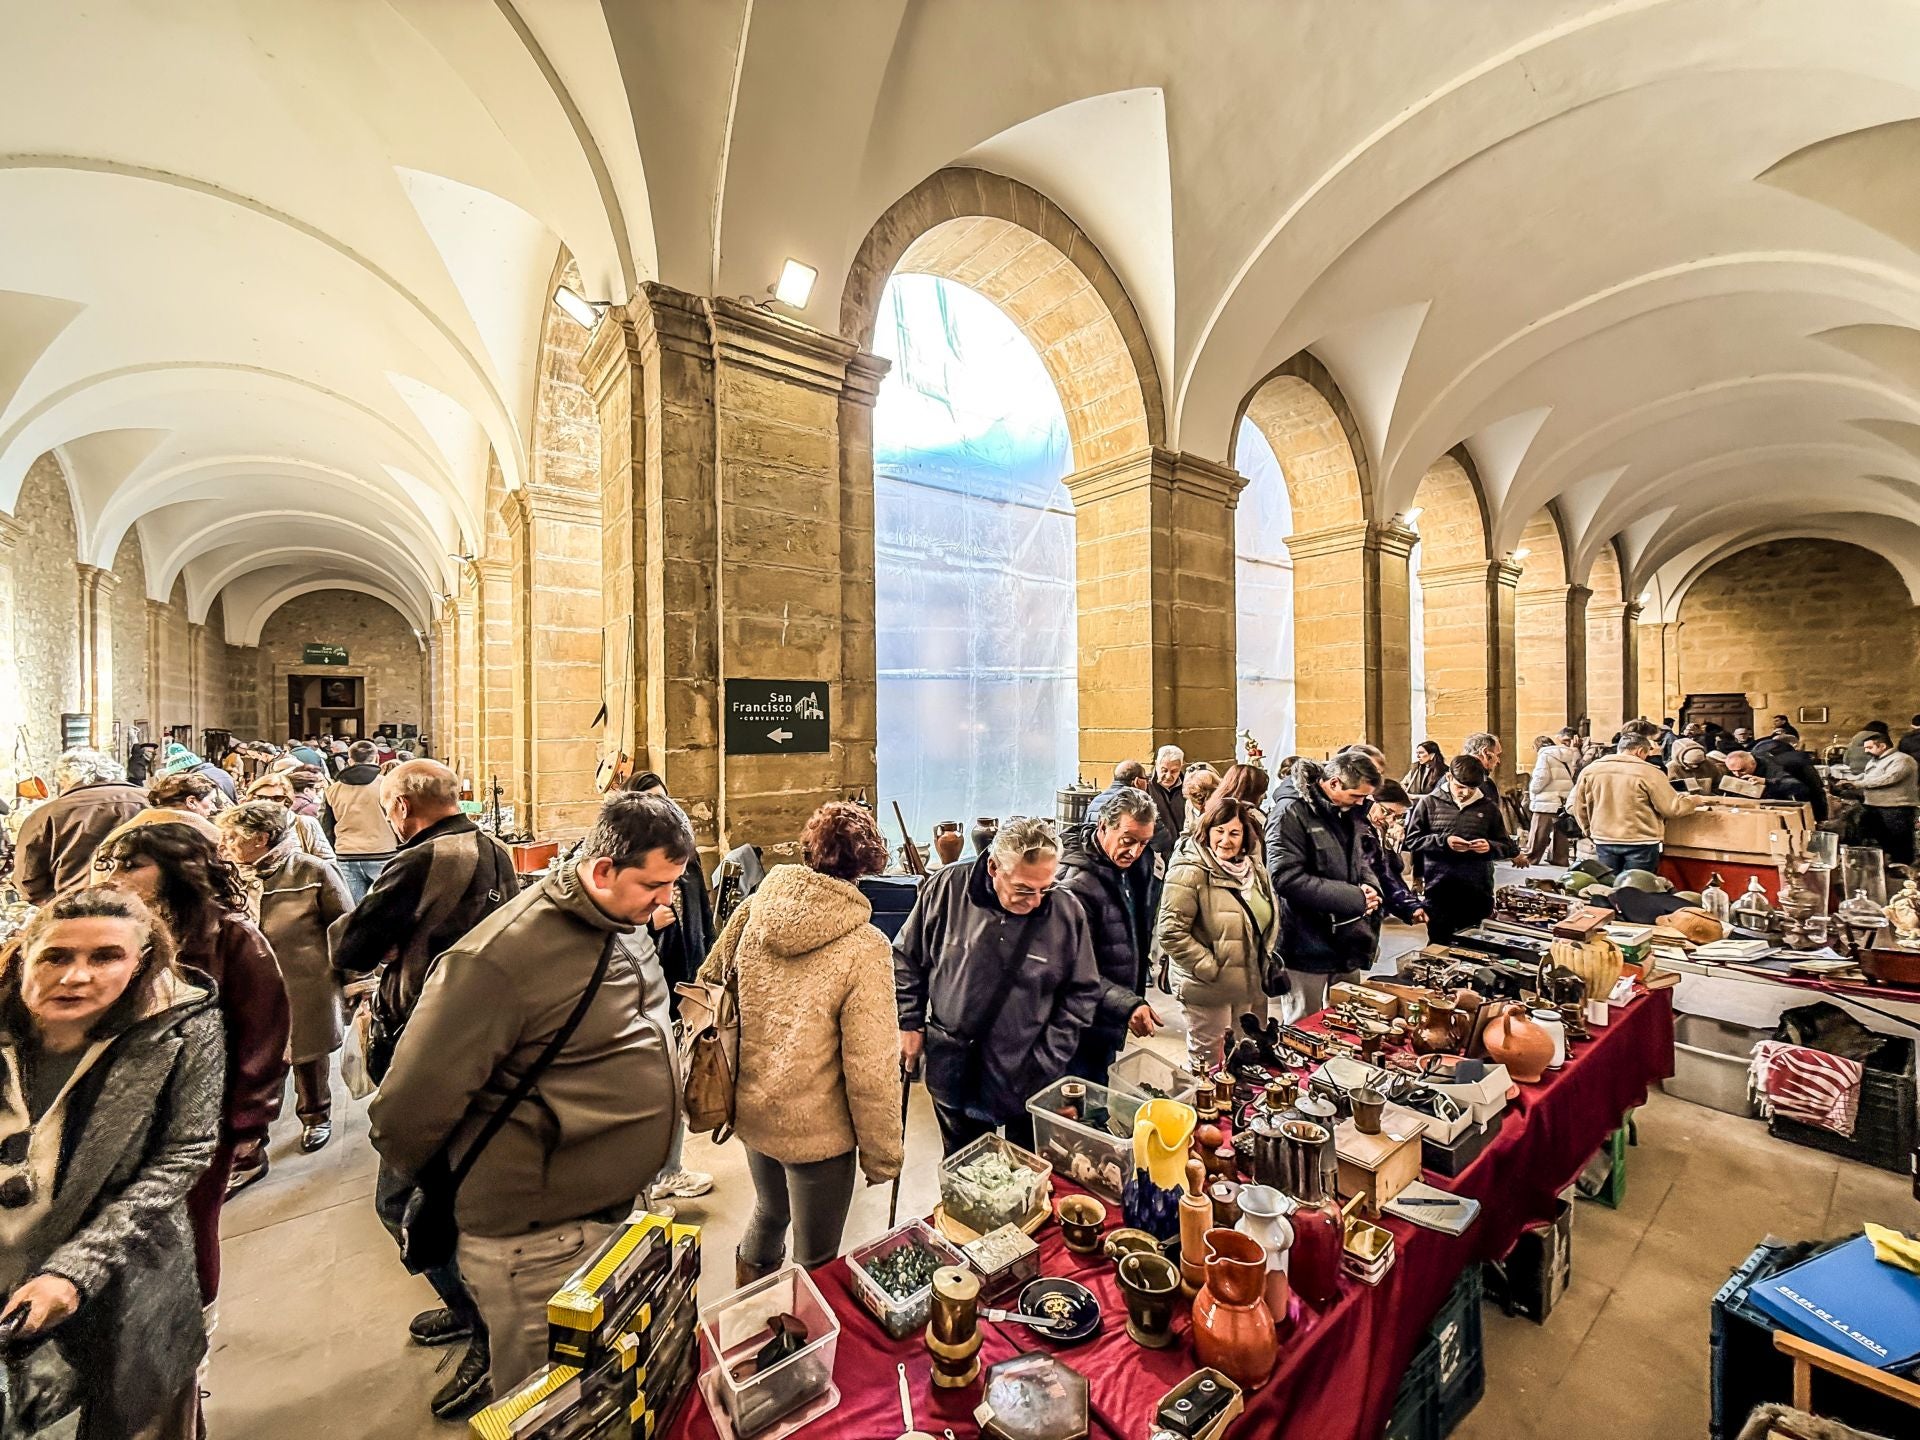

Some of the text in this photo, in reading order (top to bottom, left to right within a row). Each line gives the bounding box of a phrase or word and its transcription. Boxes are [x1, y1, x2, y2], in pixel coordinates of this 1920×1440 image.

[770, 692, 792, 703] San
[733, 702, 792, 713] Francisco
[1815, 1308, 1834, 1320] DE
[1833, 1320, 1850, 1331] LA
[1850, 1331, 1888, 1355] RIOJA
